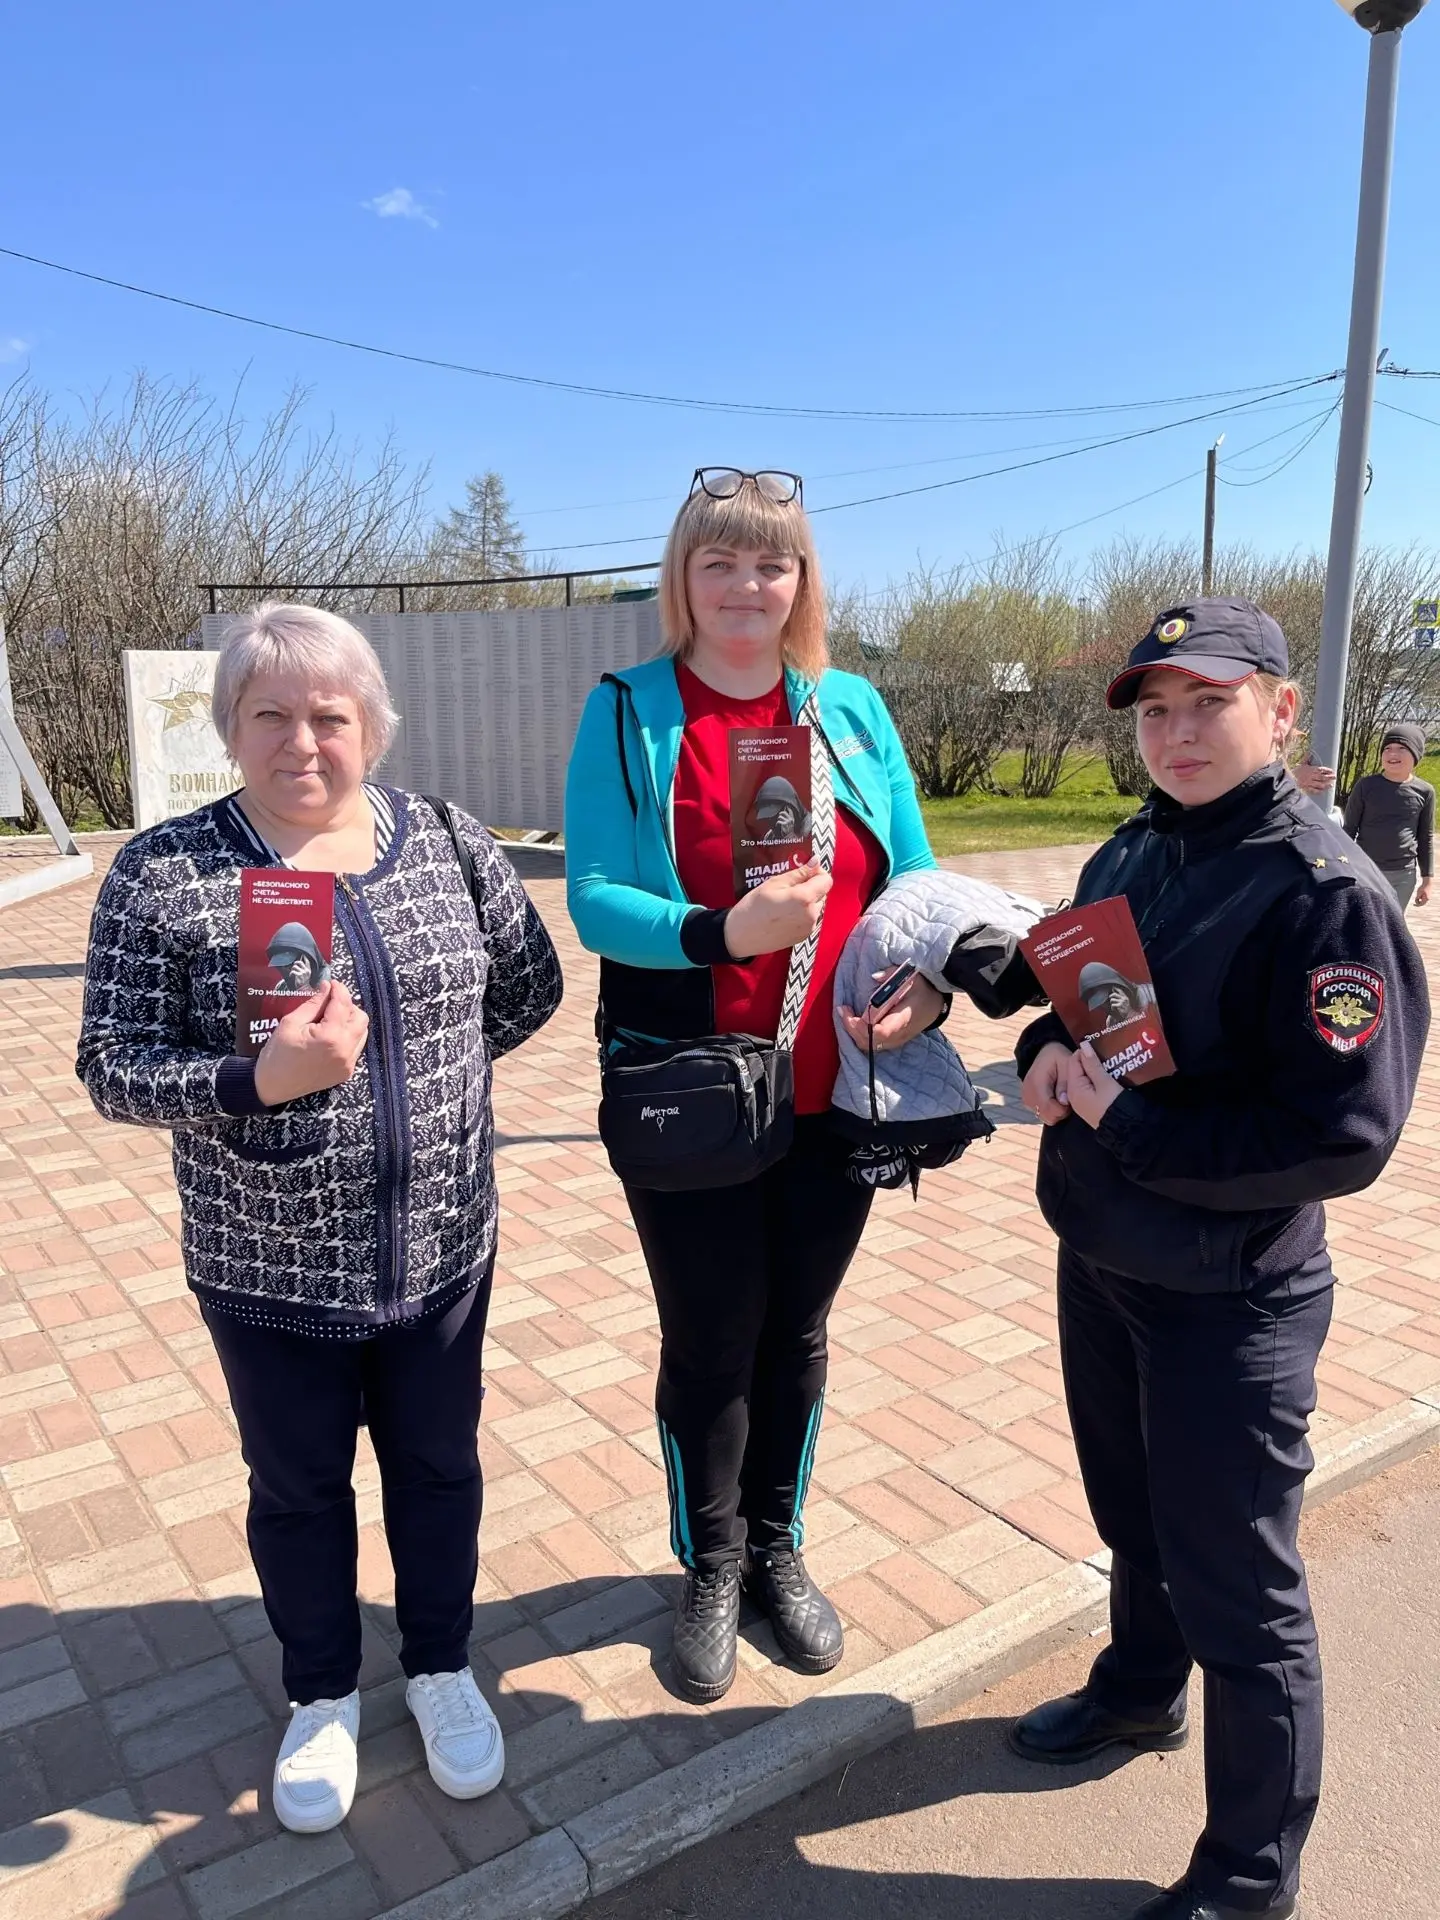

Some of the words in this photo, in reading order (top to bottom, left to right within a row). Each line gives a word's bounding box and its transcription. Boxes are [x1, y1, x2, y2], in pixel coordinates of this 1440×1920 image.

[168, 771, 247, 794] ВОИНАМ
[740, 839, 756, 847] Это
[756, 835, 804, 846] мошенники!
[745, 860, 790, 878] КЛАДИ
[252, 880, 310, 890] «БЕЗОПАСНОГО
[1041, 958, 1052, 967] НЕ
[1316, 968, 1381, 991] ПОЛИЦИЯ
[247, 987, 265, 996] Это
[1322, 982, 1372, 1001] РОССИЯ
[249, 1018, 280, 1032] КЛА
[1084, 1032, 1101, 1042] Это
[1100, 1011, 1147, 1035] мошенники!
[1331, 1034, 1358, 1052] МВД
[1102, 1040, 1143, 1071] КЛАДИ
[1108, 1048, 1153, 1080] РУБКУ!
